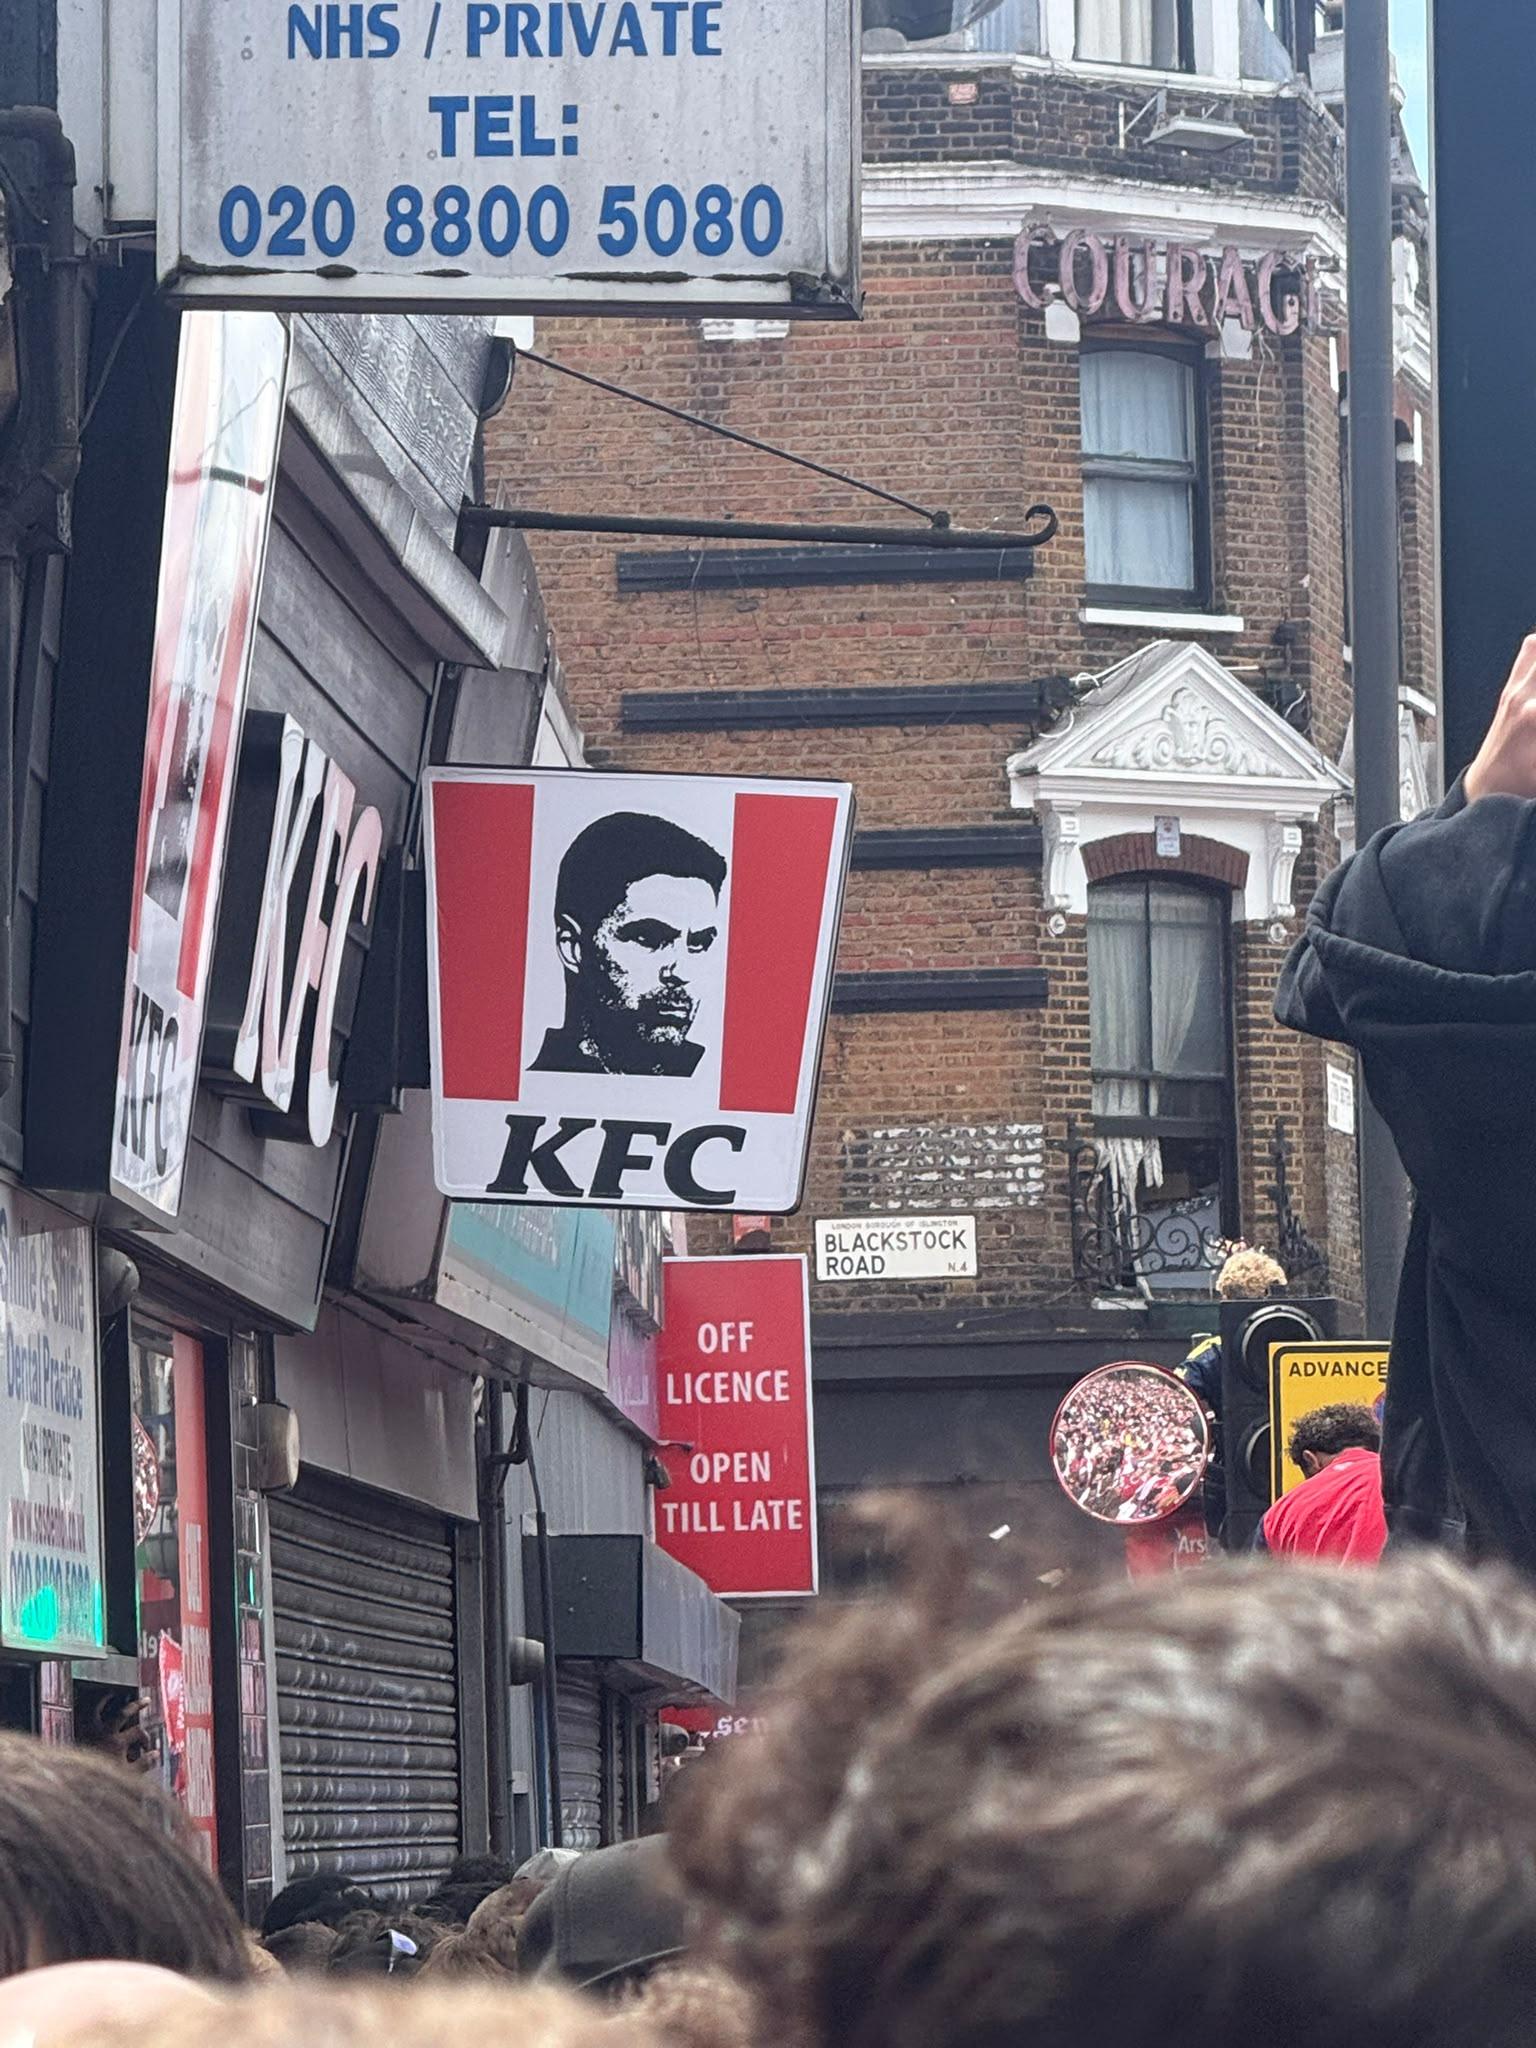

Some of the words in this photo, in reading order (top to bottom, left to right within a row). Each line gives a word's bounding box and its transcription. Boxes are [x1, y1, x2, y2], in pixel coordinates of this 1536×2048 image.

[288, 3, 399, 58] NHS
[424, 3, 441, 58] /
[467, 3, 723, 58] PRIVATE
[429, 95, 578, 156] TEL:
[219, 184, 355, 257] 020
[384, 184, 569, 257] 8800
[597, 184, 782, 257] 5080
[233, 712, 383, 1148] KFC
[120, 984, 179, 1177] KFC
[486, 1114, 747, 1206] KFC
[825, 1229, 967, 1253] BLACKSTOCK
[826, 1255, 886, 1276] ROAD
[948, 1261, 968, 1273] N.4
[697, 1321, 754, 1354] OFF
[7, 1321, 41, 1406] Dental
[43, 1334, 83, 1421] Practice
[666, 1369, 790, 1405] LICENCE
[1289, 1361, 1388, 1377] ADVANCE
[690, 1451, 771, 1484] OPEN
[662, 1502, 725, 1533] TILL
[733, 1500, 803, 1532] LATE
